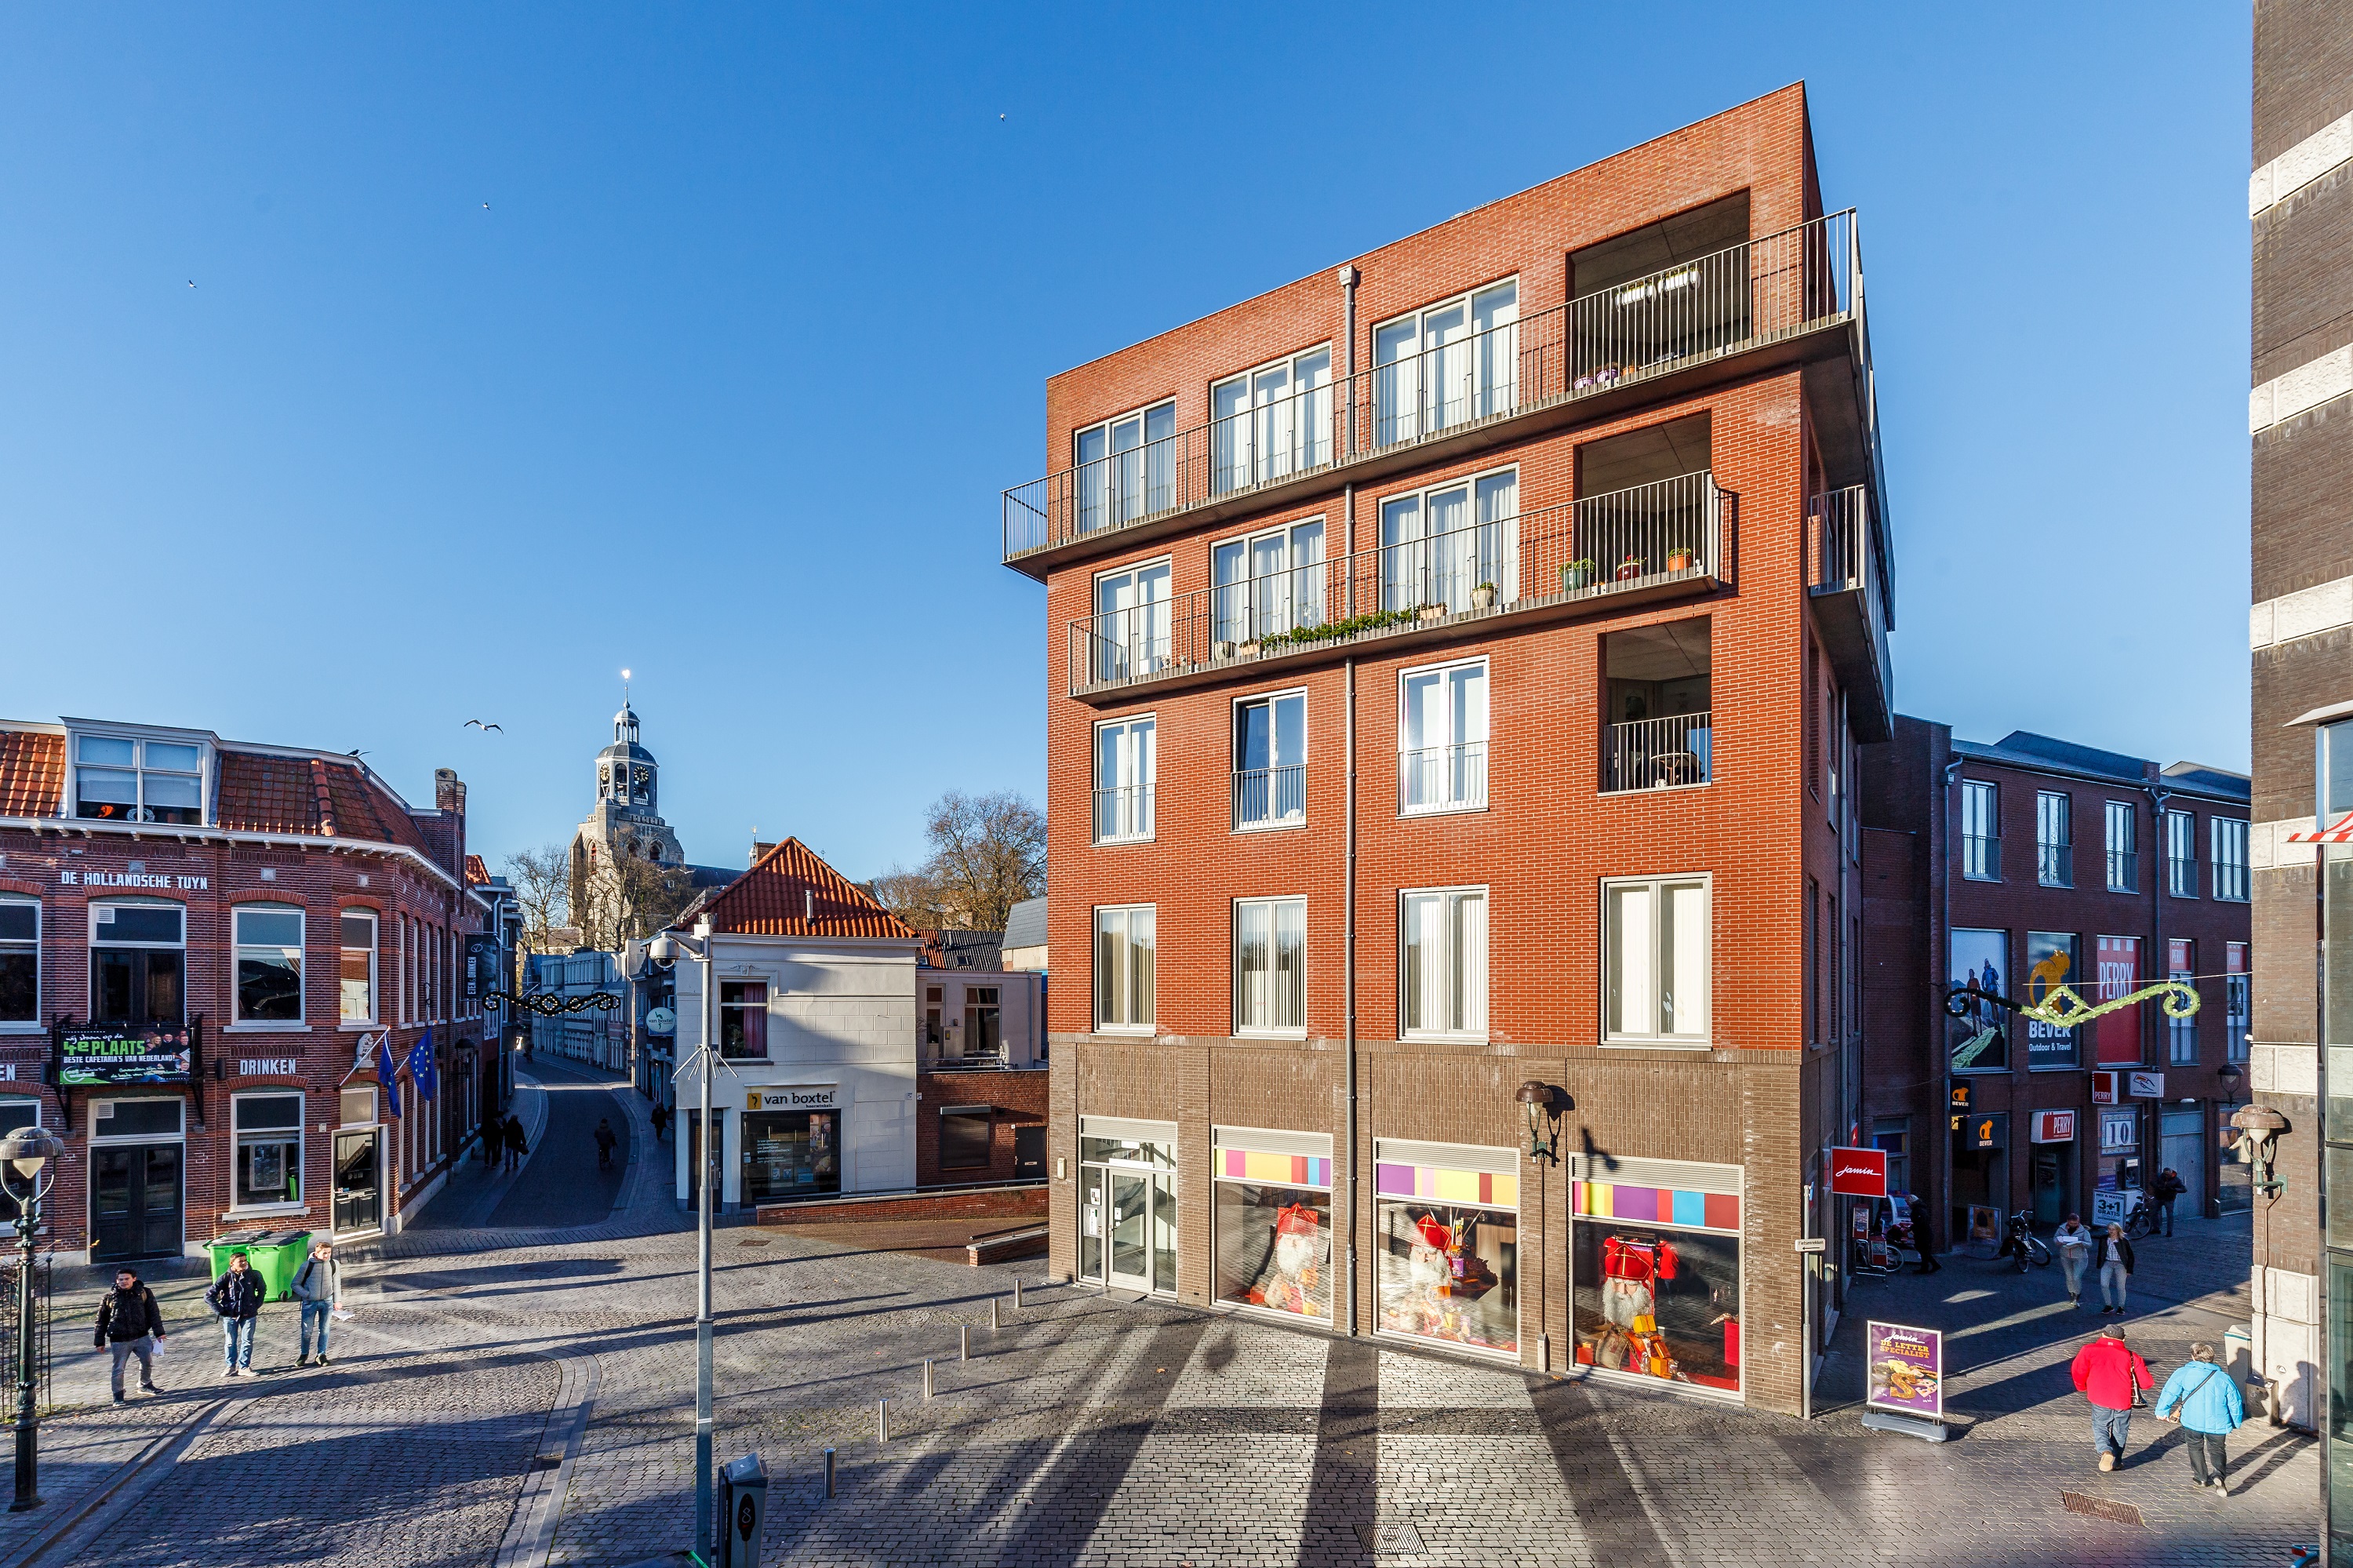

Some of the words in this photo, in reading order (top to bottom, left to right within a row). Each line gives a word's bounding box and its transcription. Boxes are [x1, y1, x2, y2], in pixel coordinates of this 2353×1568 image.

[61, 871, 78, 885] DE
[84, 872, 171, 888] HOLLANDSCHE
[176, 876, 208, 890] TUYN
[2172, 949, 2184, 964] PERRY
[2229, 951, 2241, 966] PERRY
[467, 956, 476, 978] DRINKEN
[2099, 962, 2134, 999] PERRY
[467, 982, 476, 995] ETEN
[2028, 1020, 2071, 1038] BEVER
[66, 1035, 78, 1045] wij
[2051, 1042, 2056, 1051] &
[64, 1041, 89, 1056] 4e
[91, 1040, 145, 1056] PLAATS
[239, 1059, 296, 1075] DRINKEN
[764, 1095, 788, 1104] van
[791, 1091, 834, 1104] boxtel
[2094, 1091, 2111, 1100] PERRY
[2053, 1115, 2071, 1133] PERRY
[2110, 1122, 2129, 1145] 10
[1835, 1165, 1882, 1177] jamin
[2098, 1199, 2120, 1212] 3+1
[1883, 1331, 1925, 1344] jamin
[1879, 1345, 1930, 1359] SPECIALIST
[1895, 1341, 1929, 1352] LETTER
